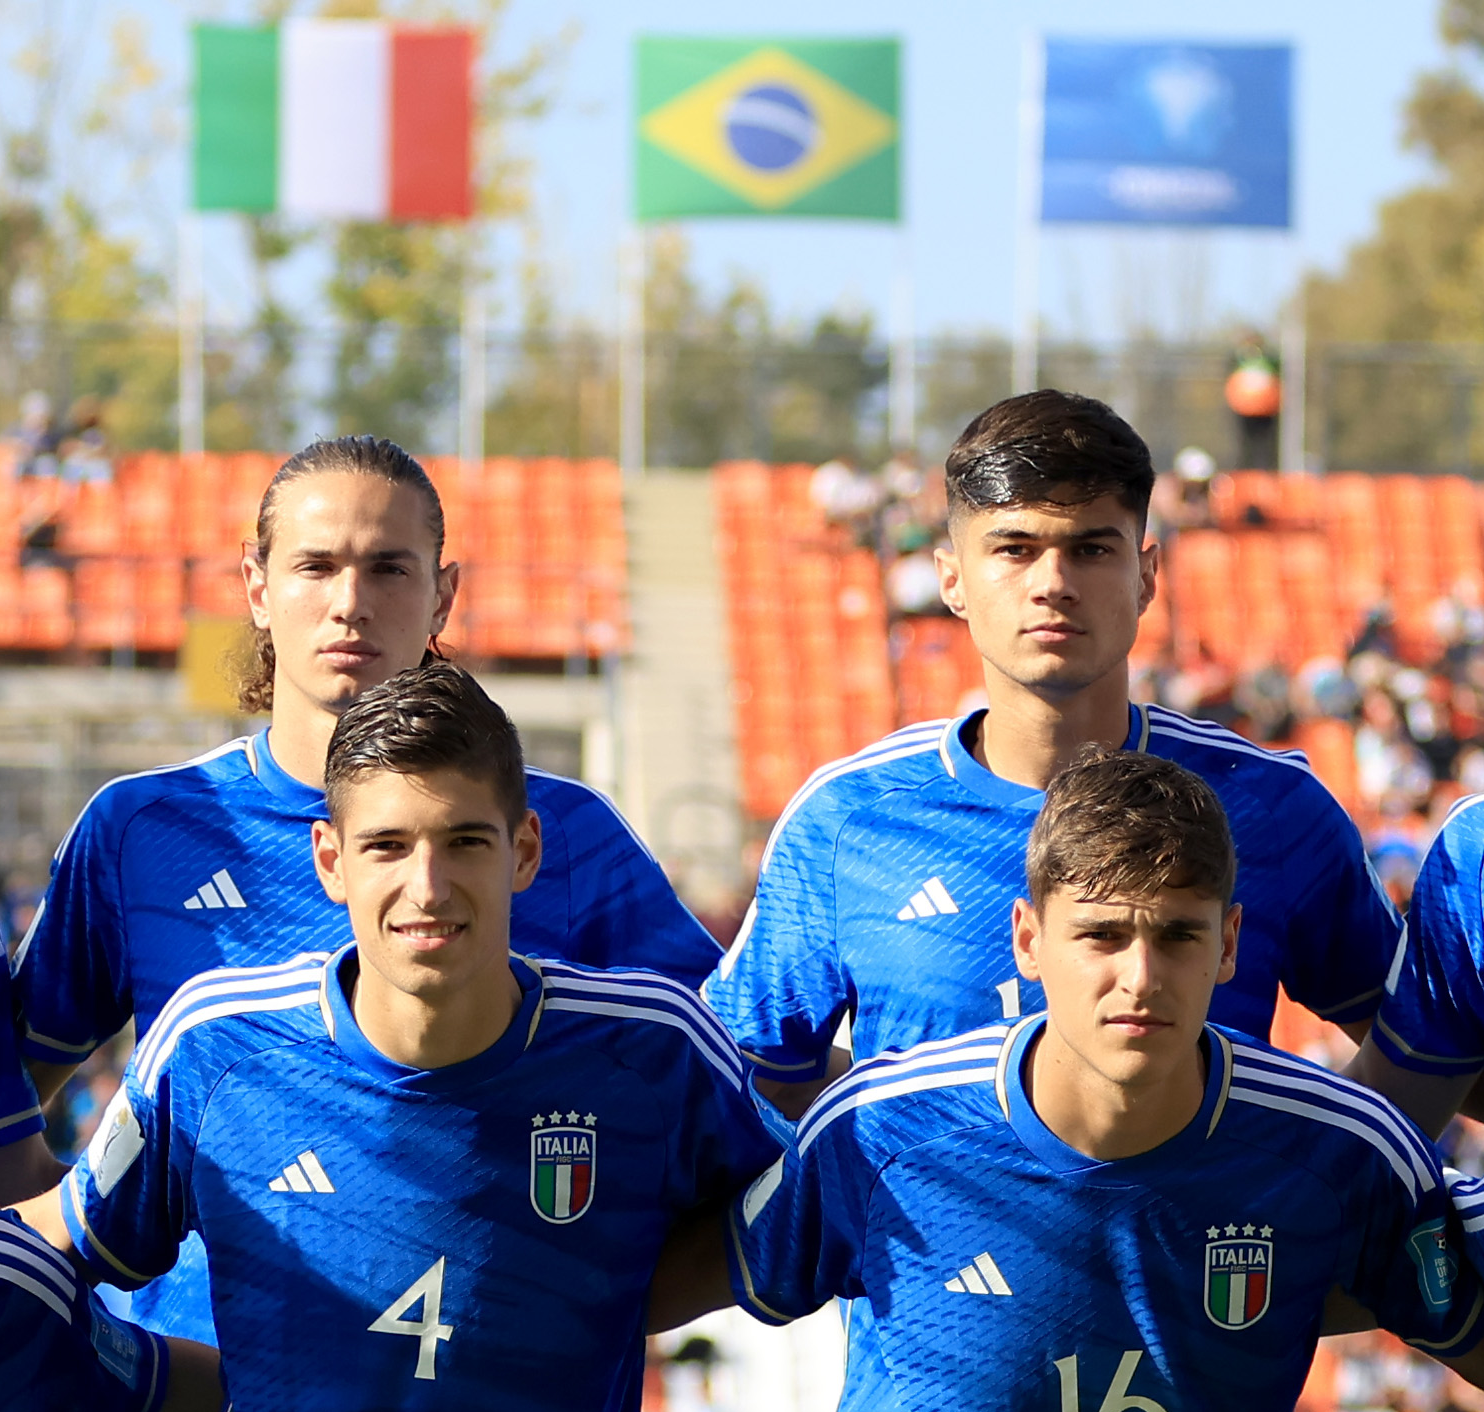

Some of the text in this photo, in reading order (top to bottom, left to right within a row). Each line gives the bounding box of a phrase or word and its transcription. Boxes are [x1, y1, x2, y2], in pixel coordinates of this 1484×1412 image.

[537, 1136, 590, 1155] ITALIA
[1211, 1248, 1266, 1266] ITALIA
[366, 1256, 454, 1380] 4
